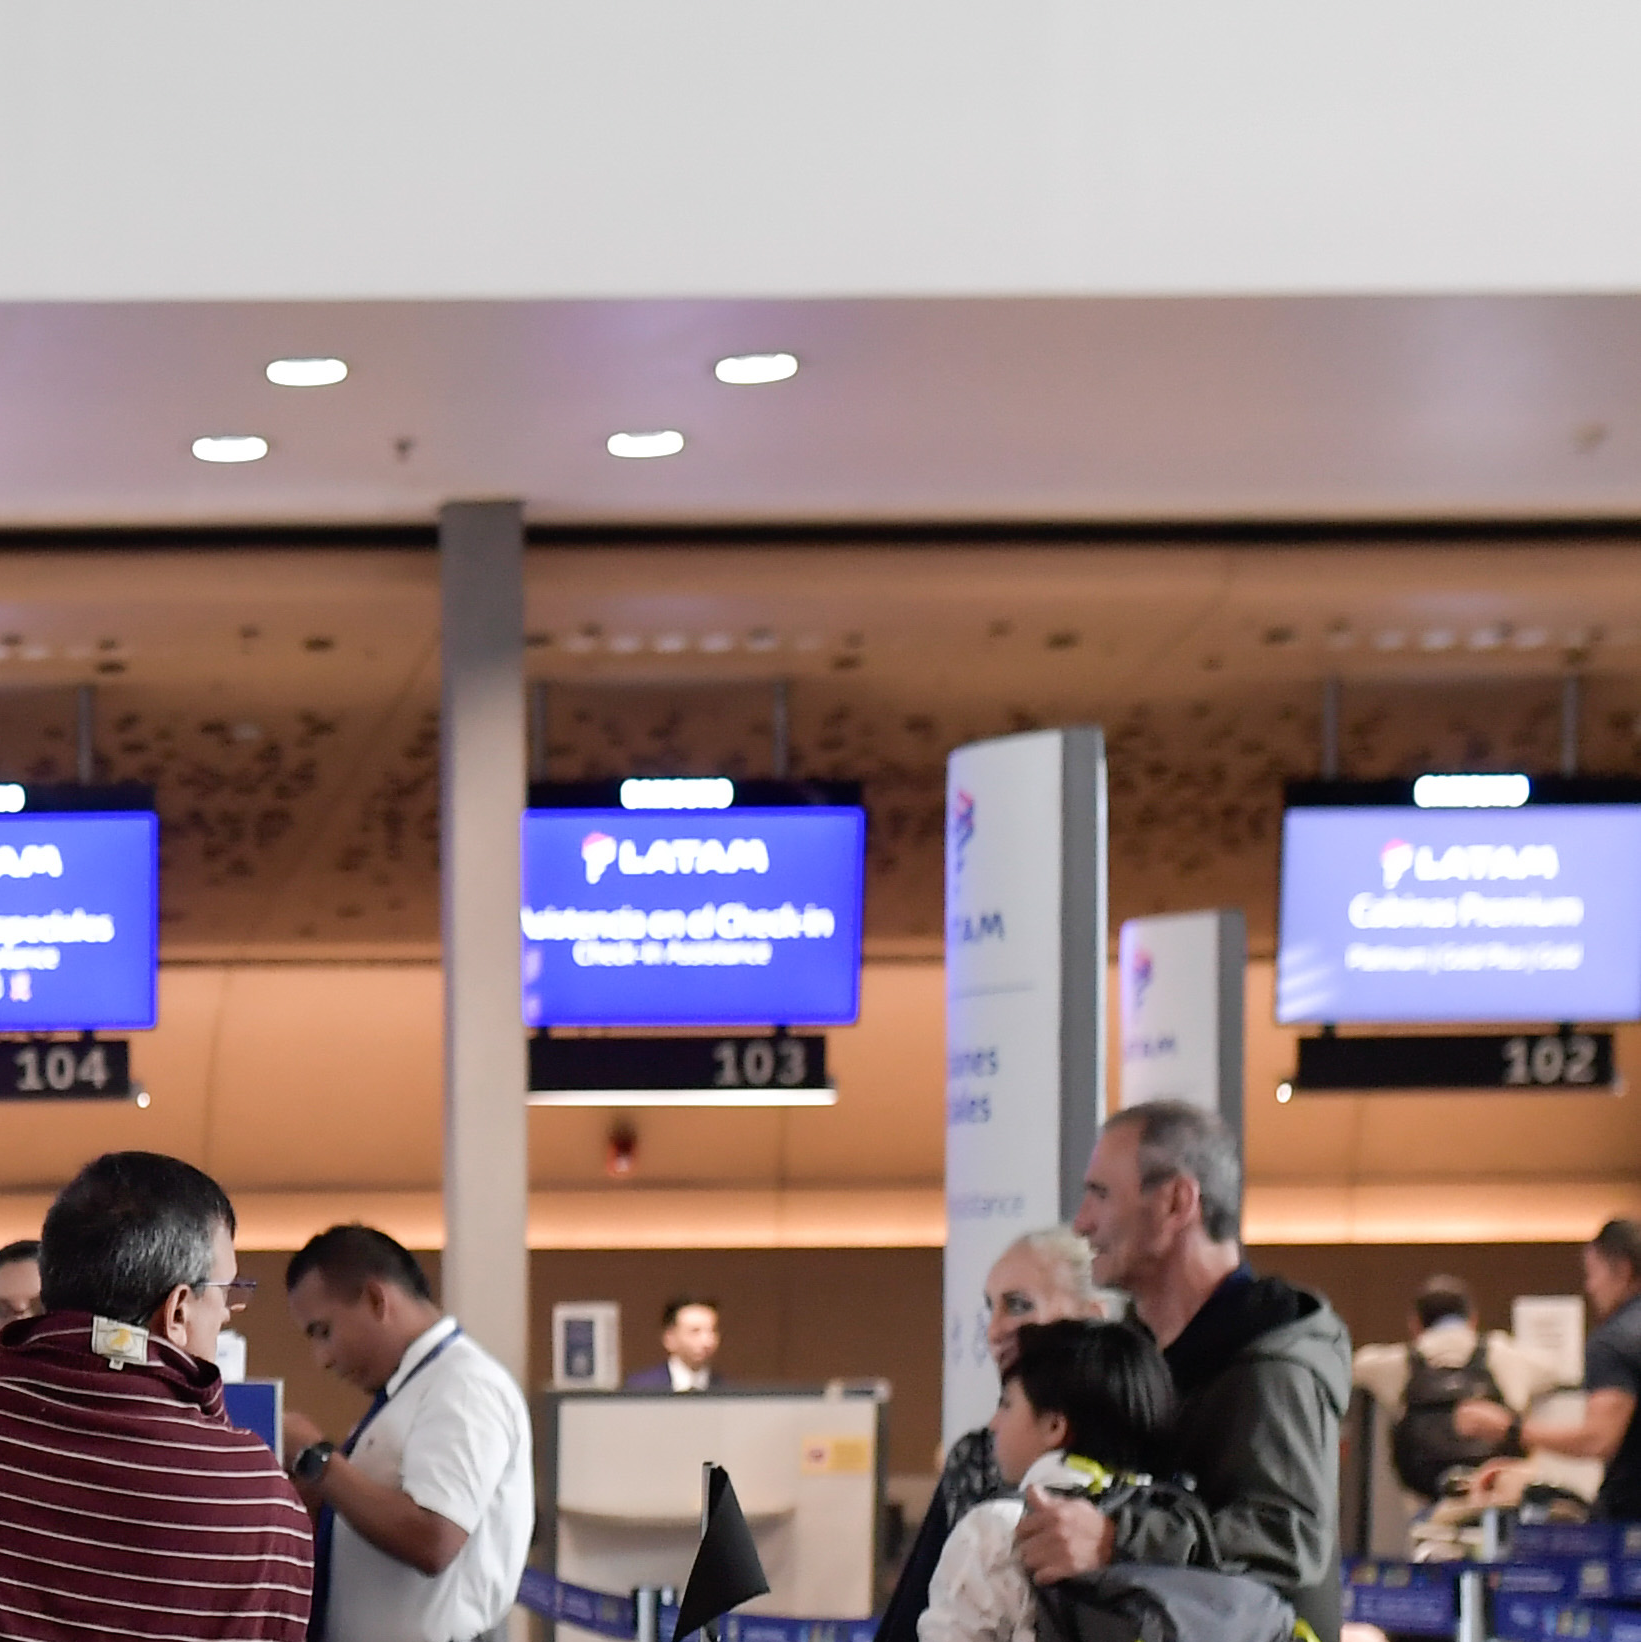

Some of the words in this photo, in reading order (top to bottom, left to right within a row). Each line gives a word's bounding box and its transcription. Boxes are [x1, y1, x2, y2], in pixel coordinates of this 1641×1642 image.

[618, 838, 770, 874] LATAM
[15, 1047, 110, 1091] 104
[713, 1039, 806, 1085] 103
[1503, 1036, 1598, 1084] 102
